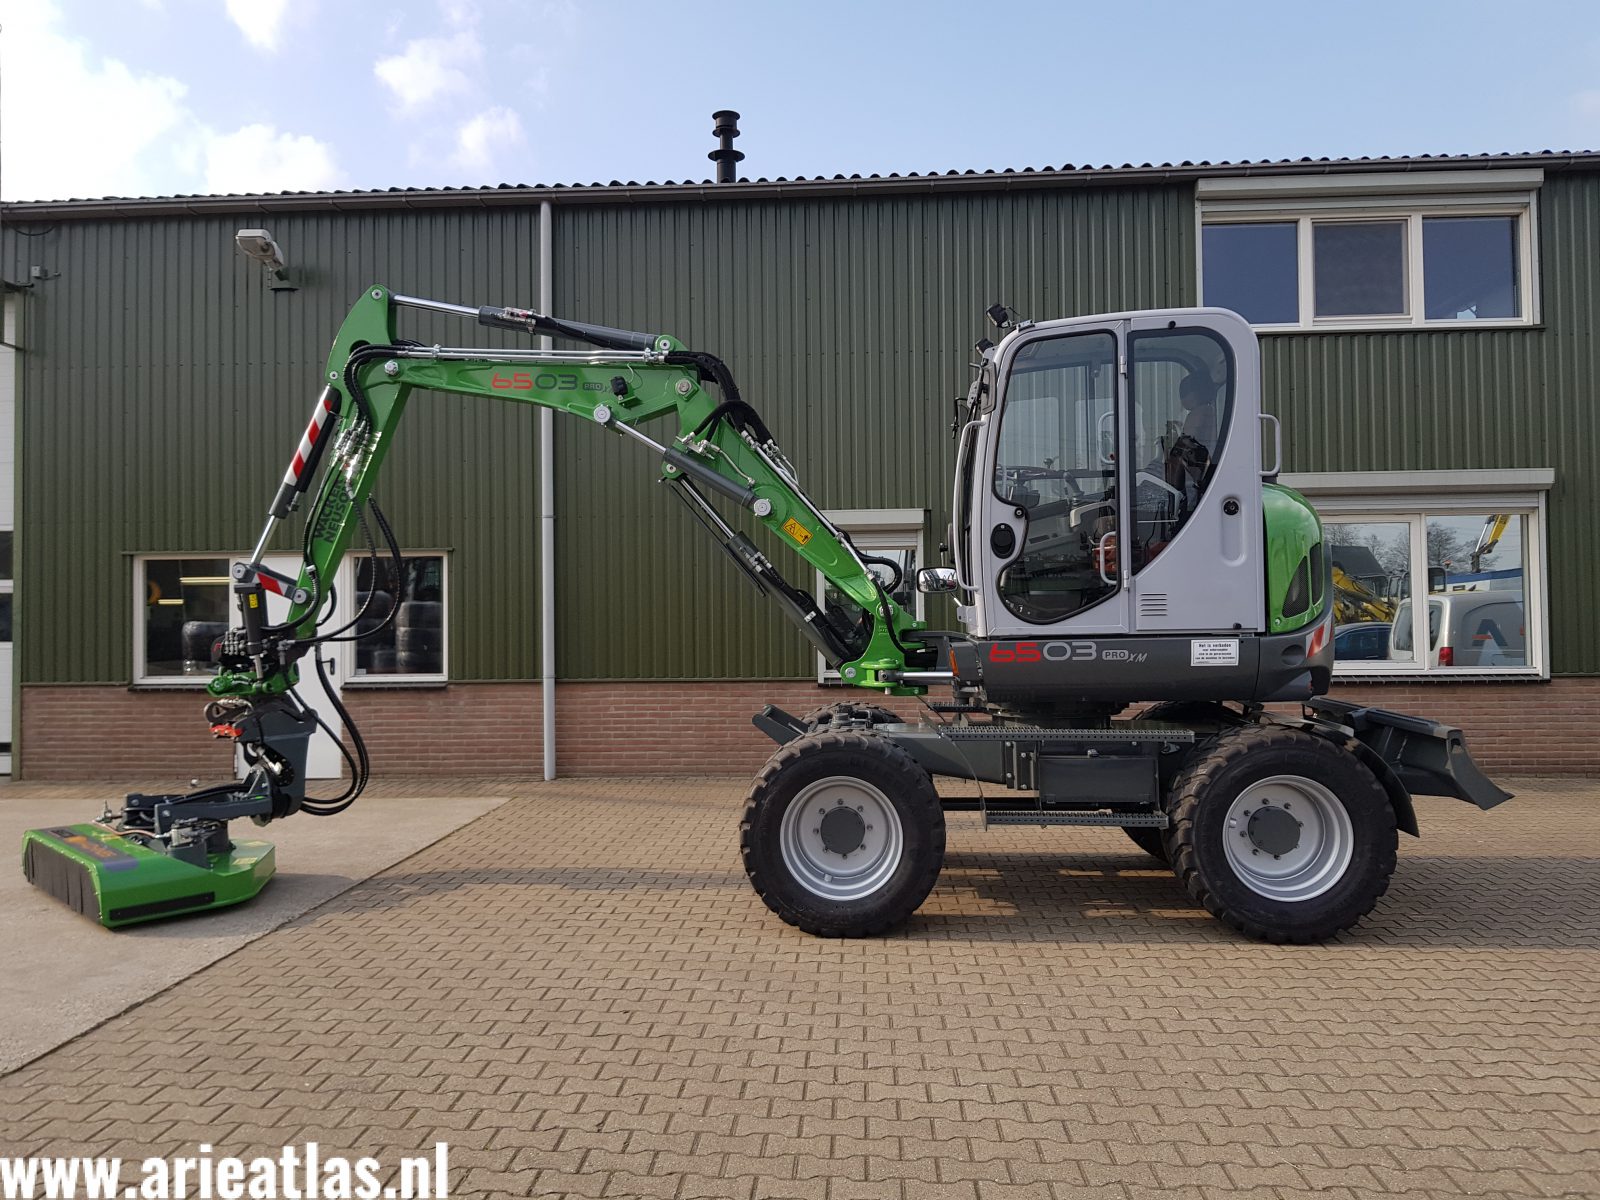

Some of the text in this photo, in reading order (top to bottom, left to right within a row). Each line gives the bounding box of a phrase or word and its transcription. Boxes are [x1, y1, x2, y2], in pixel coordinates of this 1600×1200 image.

[491, 373, 578, 390] 6503
[323, 482, 351, 543] NEUSO
[989, 641, 1097, 662] 6503
[1103, 650, 1128, 660] PRO
